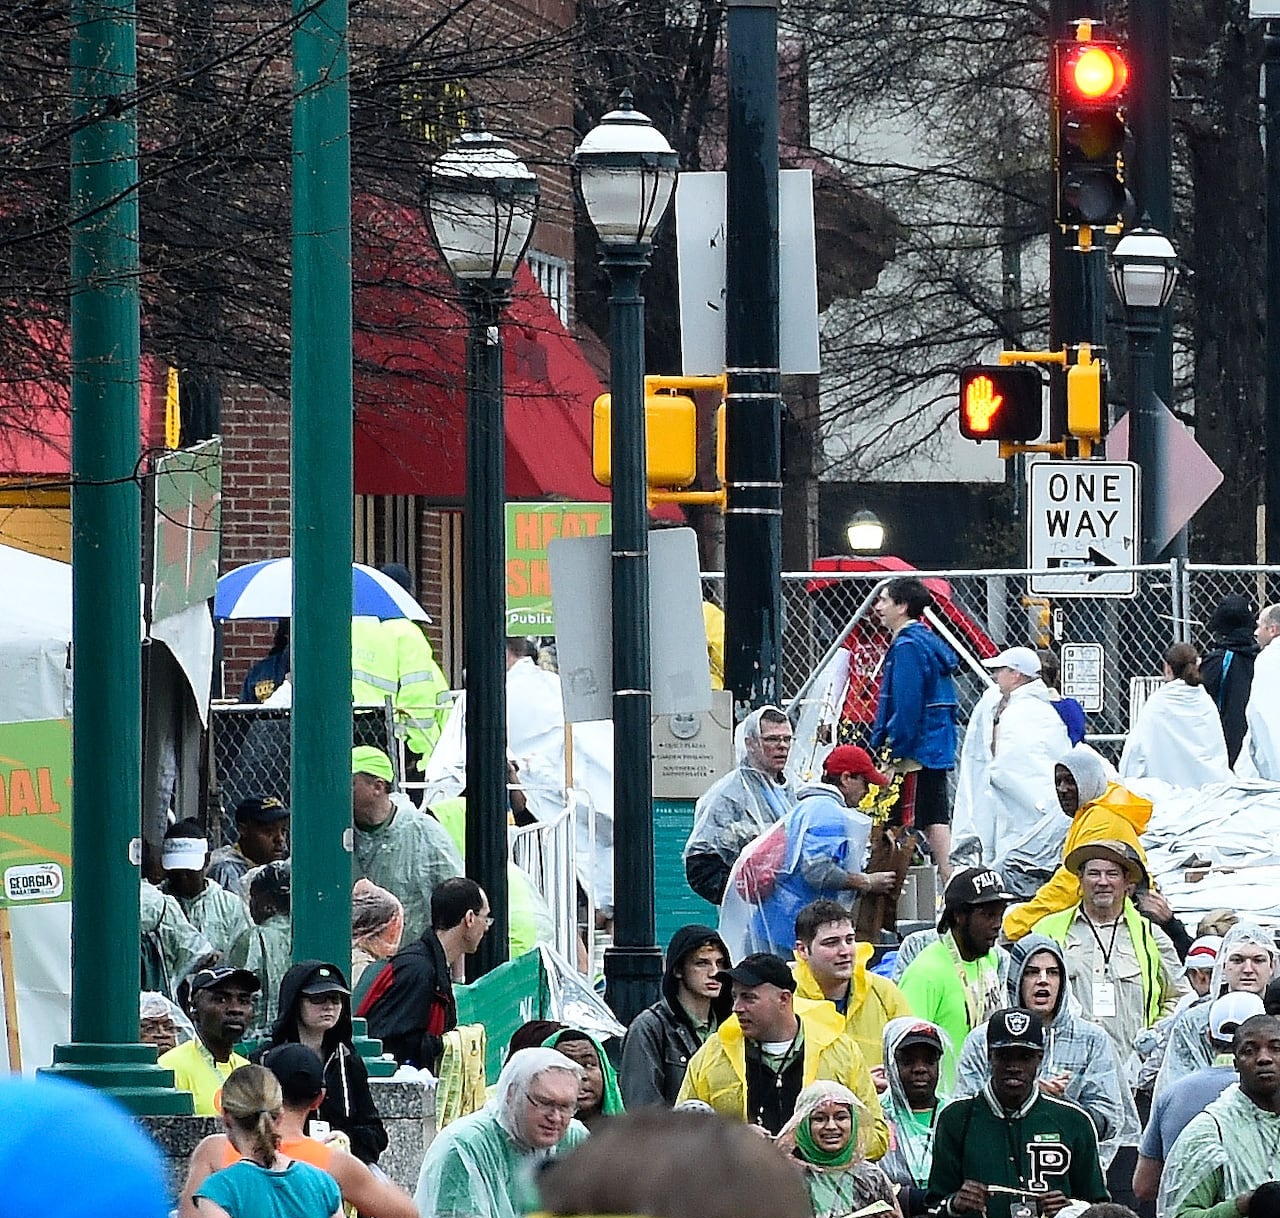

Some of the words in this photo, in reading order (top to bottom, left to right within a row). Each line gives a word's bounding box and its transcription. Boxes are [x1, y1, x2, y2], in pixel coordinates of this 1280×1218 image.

[1049, 473, 1121, 502] ONE
[515, 512, 602, 550] HEAT
[1046, 509, 1119, 538] WAY
[510, 613, 553, 624] Publix
[0, 767, 61, 817] AL
[9, 874, 53, 890] GEORGIA
[1026, 1142, 1072, 1192] P
